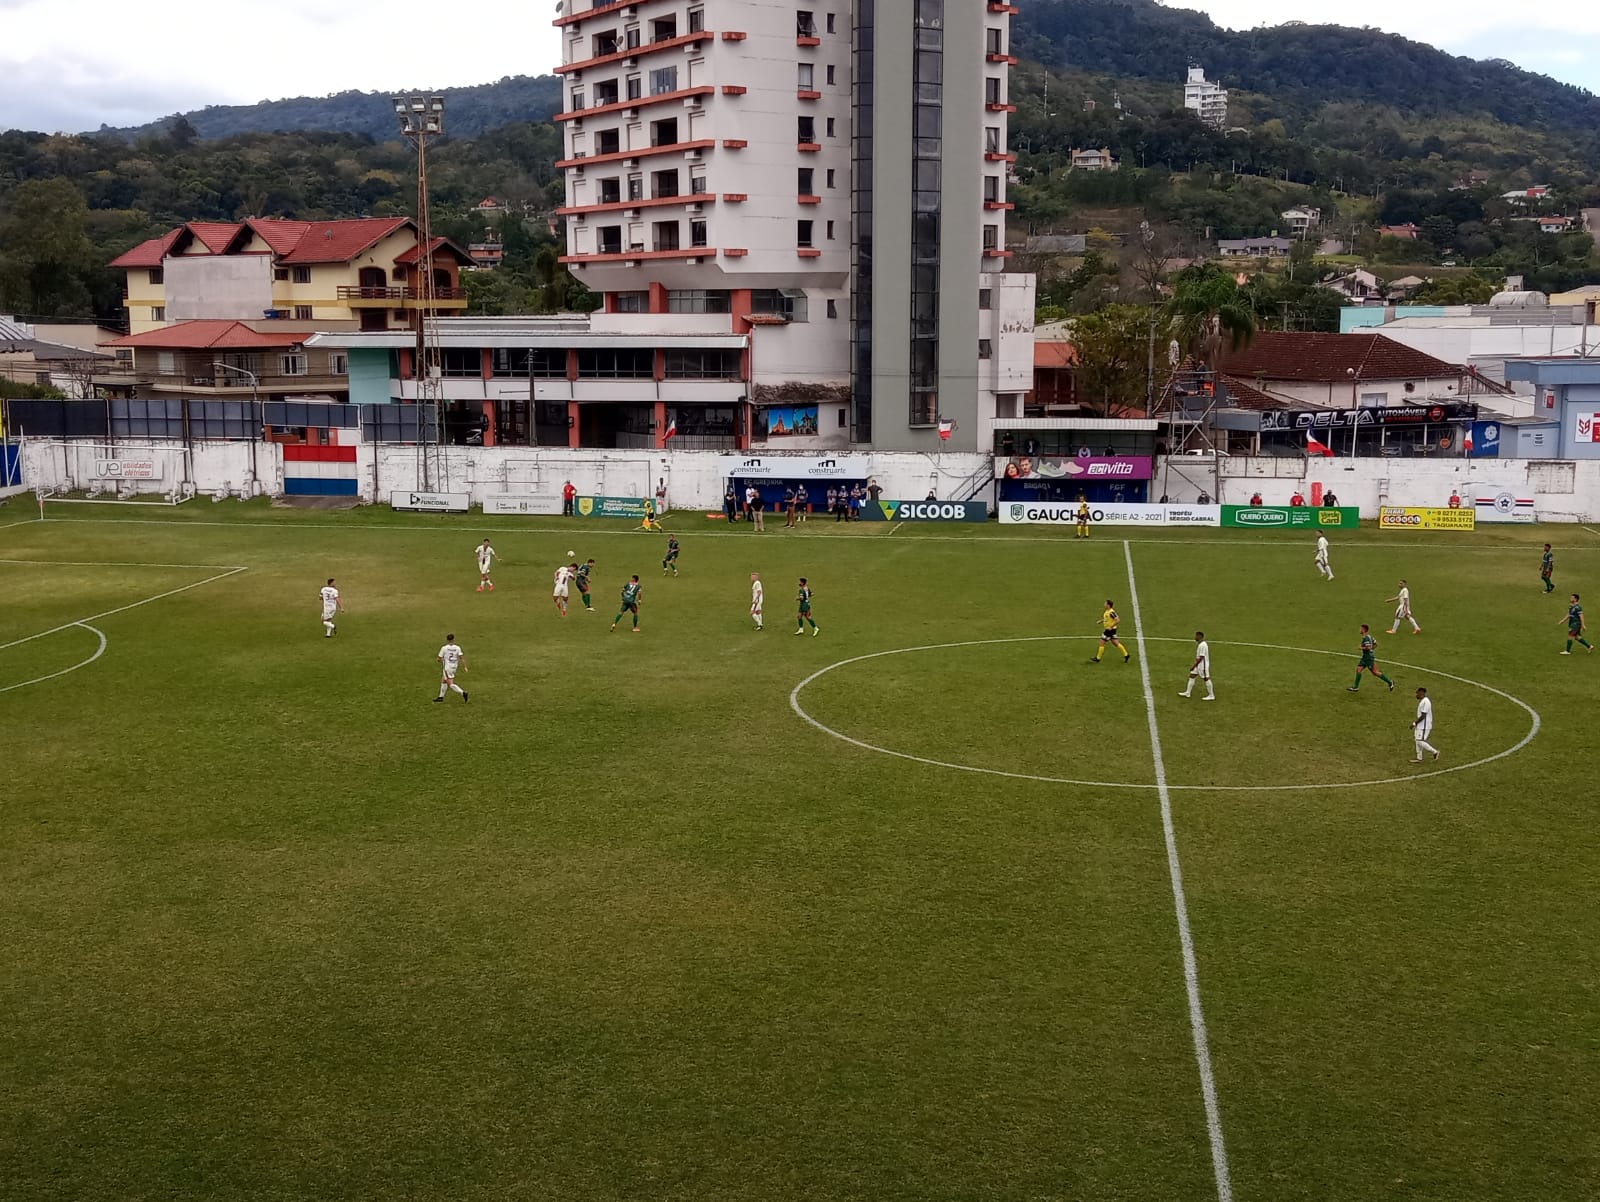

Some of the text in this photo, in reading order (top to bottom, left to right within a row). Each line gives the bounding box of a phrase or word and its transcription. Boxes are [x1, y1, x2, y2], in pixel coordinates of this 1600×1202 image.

[1376, 408, 1426, 418] AUTOMÓVEIS
[1296, 410, 1375, 428] DELTA
[734, 466, 772, 474] construarte
[808, 467, 847, 475] construarte
[900, 504, 966, 519] SICOOB
[1105, 511, 1128, 521] SÉRIE
[1129, 513, 1139, 521] A2
[1145, 513, 1162, 521] 2021
[1240, 513, 1261, 521] QUERO
[1262, 513, 1284, 521] QUERO
